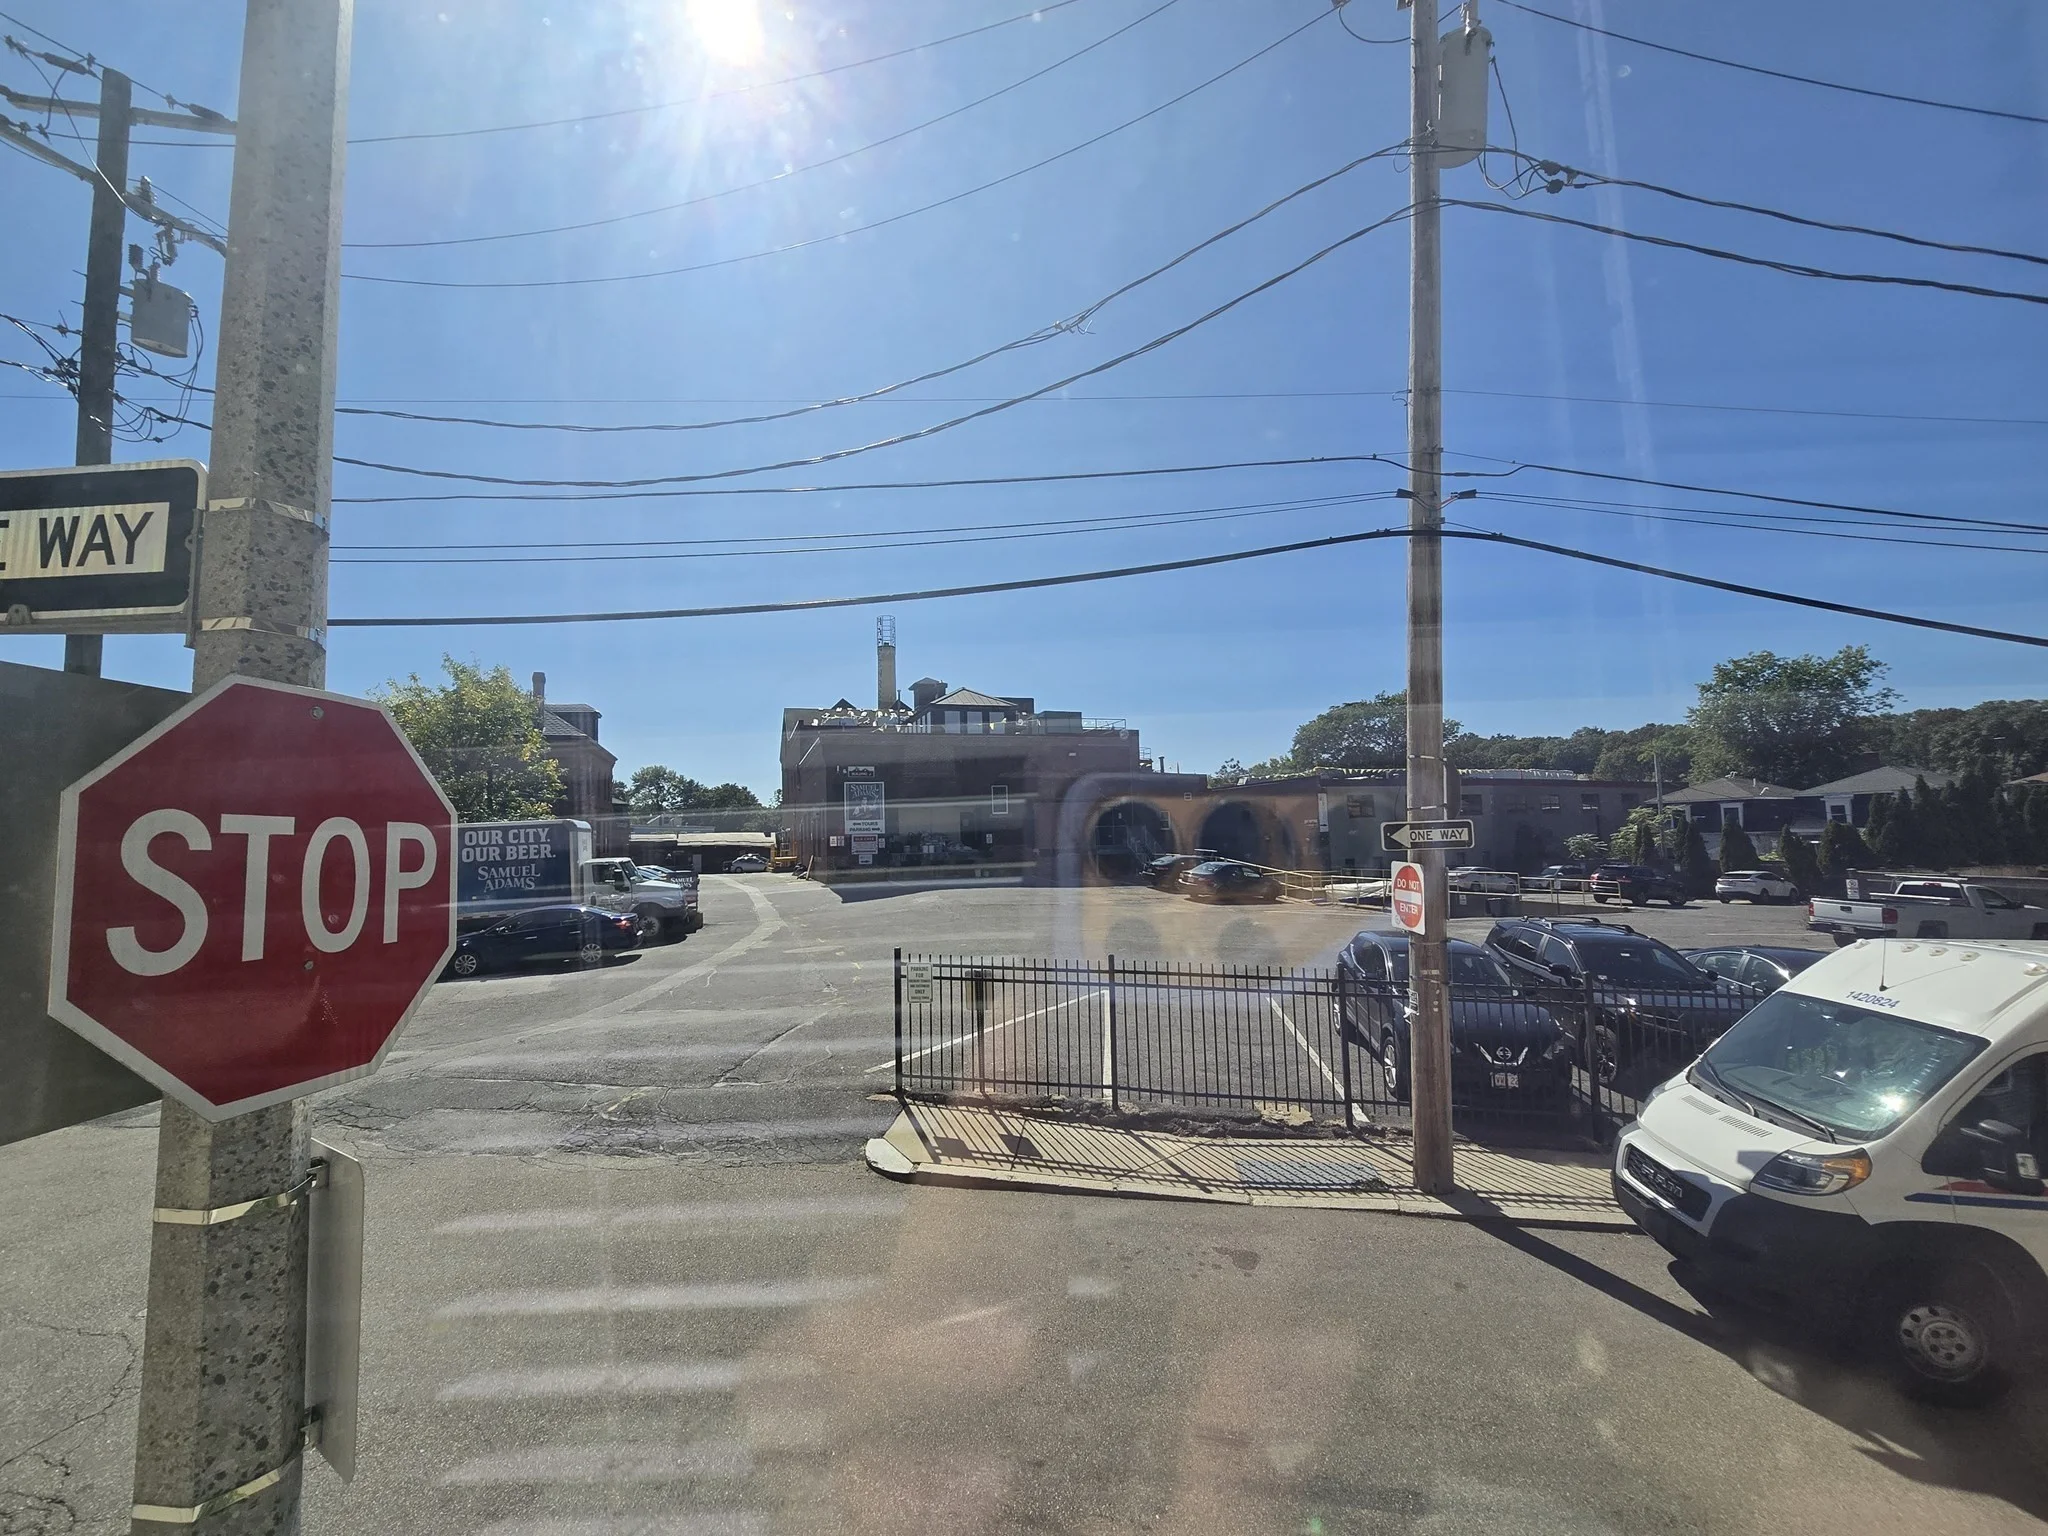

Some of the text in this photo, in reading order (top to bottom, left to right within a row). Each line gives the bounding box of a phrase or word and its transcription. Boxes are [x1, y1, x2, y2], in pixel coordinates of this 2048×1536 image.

[39, 511, 154, 569] WAY
[464, 827, 551, 846] OUR CITY.
[1410, 829, 1465, 841] ONE WAY
[461, 844, 556, 863] OUR BEER.
[478, 863, 541, 880] SAMUEL
[106, 808, 437, 976] STOP
[483, 877, 536, 893] ADAMS
[1397, 878, 1420, 890] DO NOT
[1400, 902, 1418, 915] ENTER
[1845, 990, 1901, 1009] 1420824
